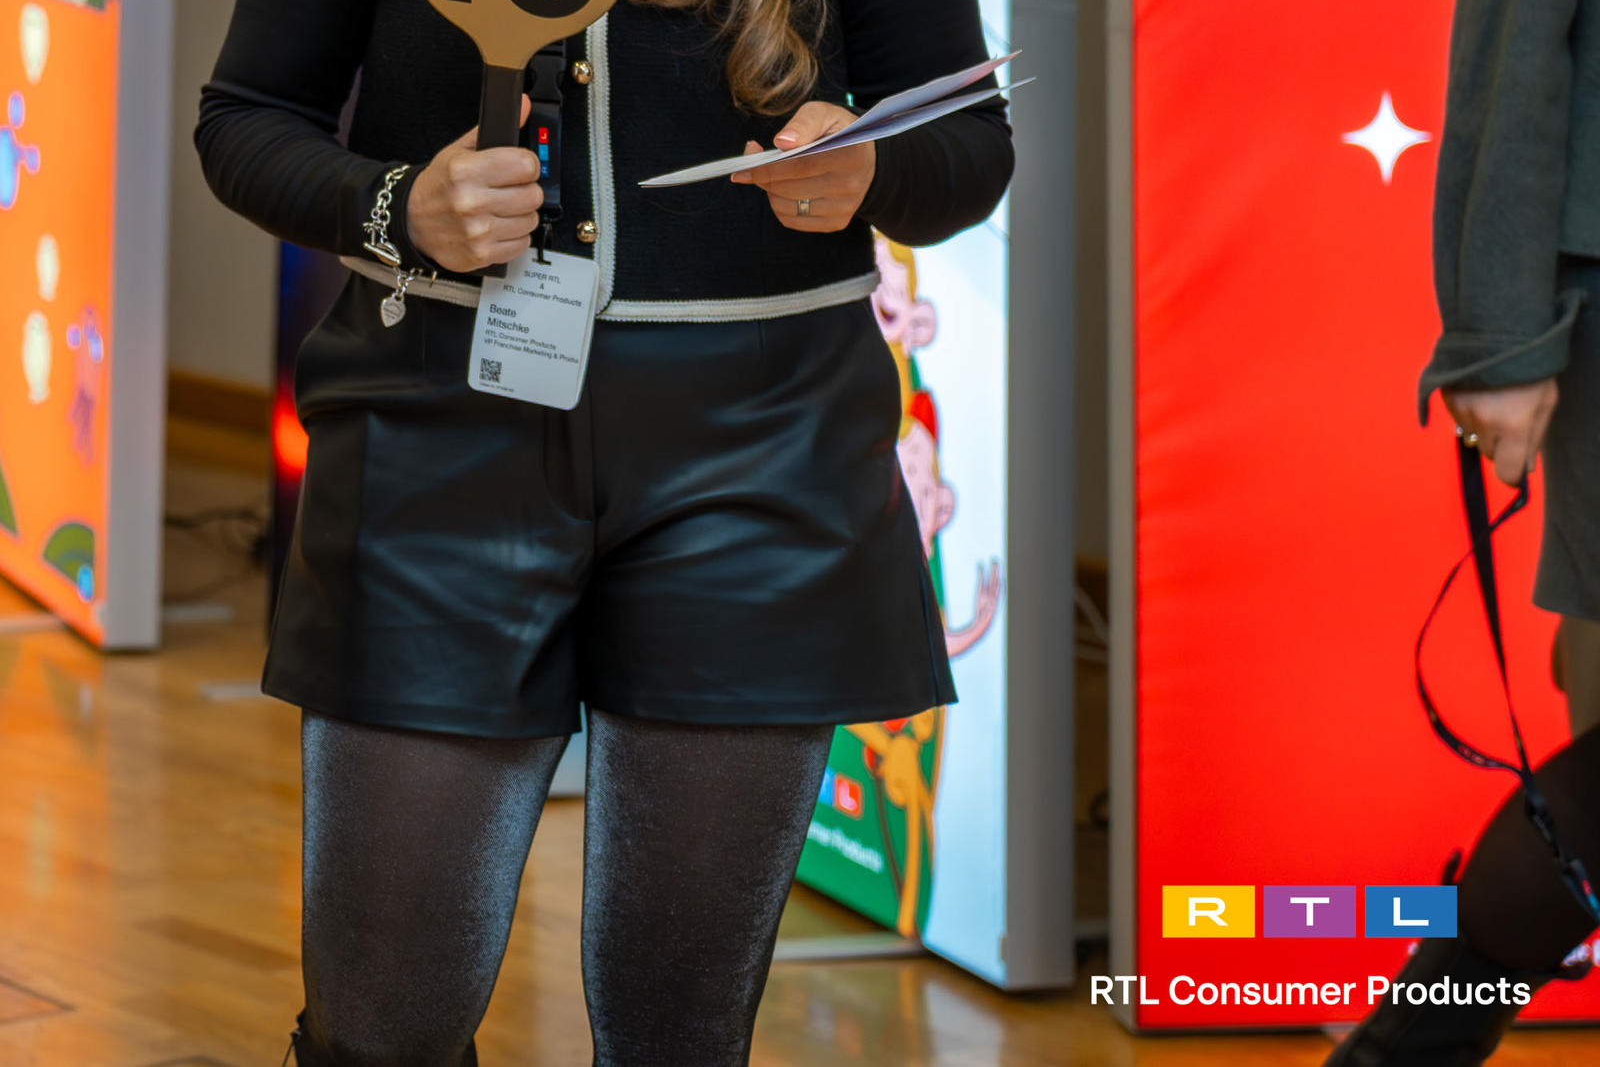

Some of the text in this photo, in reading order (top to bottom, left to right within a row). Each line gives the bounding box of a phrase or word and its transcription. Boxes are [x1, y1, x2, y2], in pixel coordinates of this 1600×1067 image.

[503, 284, 582, 307] RTL Consumer Products
[489, 303, 517, 318] Beate
[487, 317, 530, 334] Mitschke
[499, 332, 529, 344] Consumer
[530, 339, 557, 350] Products
